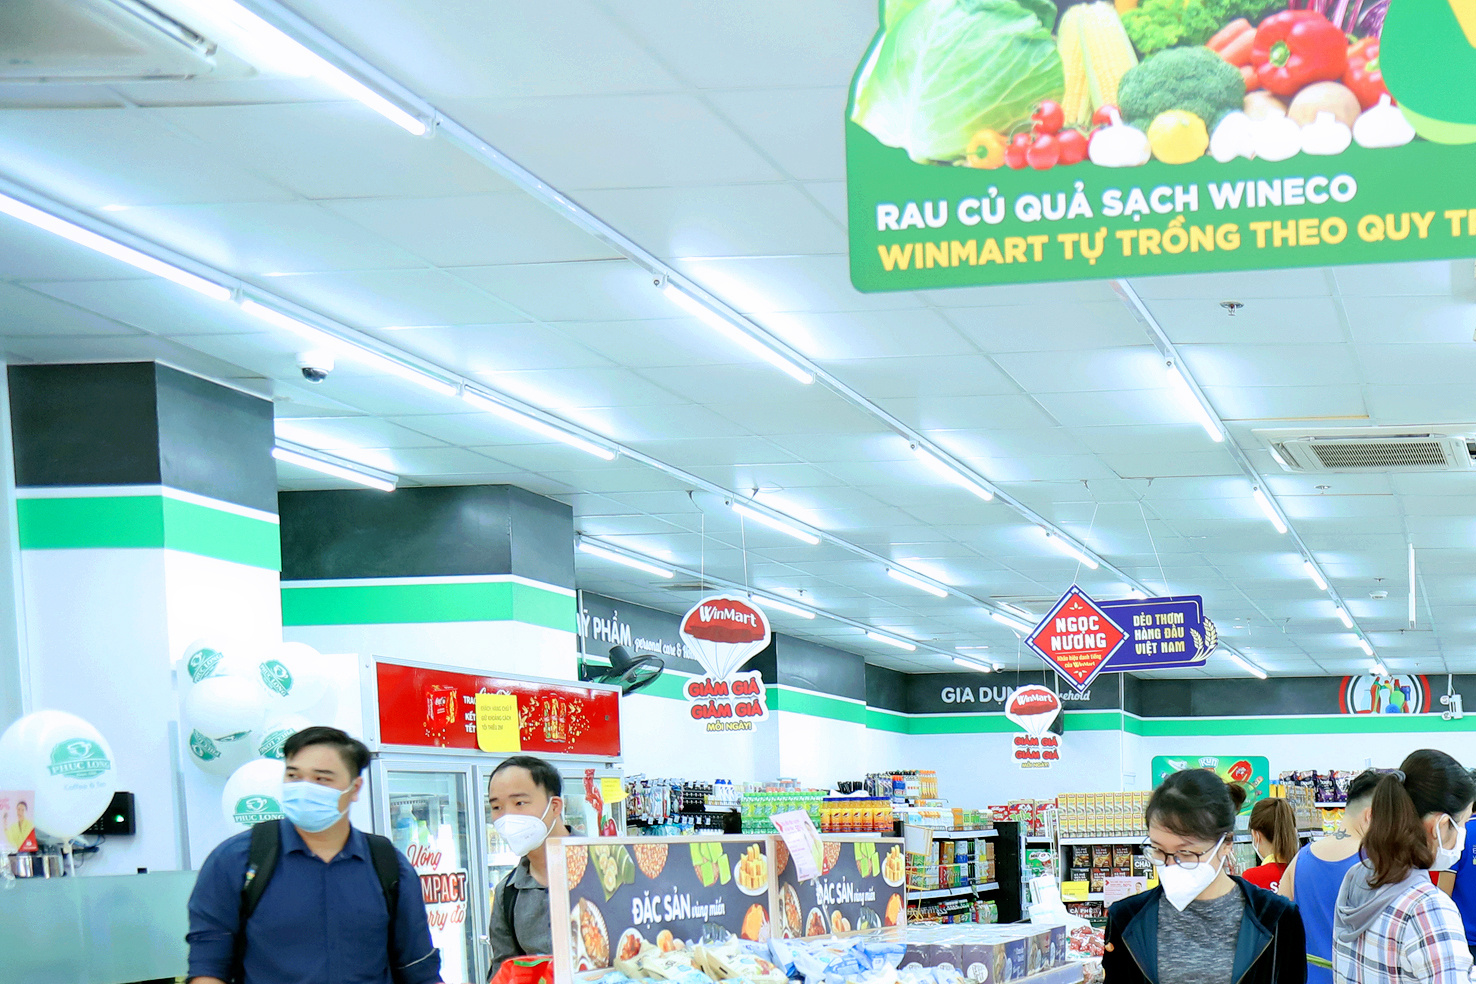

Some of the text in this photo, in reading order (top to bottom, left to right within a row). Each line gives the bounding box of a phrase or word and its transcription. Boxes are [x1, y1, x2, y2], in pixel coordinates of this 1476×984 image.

[877, 173, 1358, 231] RAU CỦ QUẢ SẠCH WINECO
[877, 235, 1048, 272] WINMART
[1057, 227, 1108, 266] TỰ
[1115, 215, 1241, 256] TRỒNG
[1250, 216, 1348, 248] THEO
[1357, 211, 1436, 242] QUY
[699, 605, 758, 628] WinMart
[1055, 615, 1100, 634] NGỌC
[1133, 612, 1185, 627] DẺO THƠM
[593, 610, 632, 647] PHẨM
[1134, 624, 1185, 641] HÀNG ĐẦU
[1050, 633, 1107, 651] NƯƠNG
[1135, 641, 1186, 656] VIỆT NAM
[688, 677, 760, 697] GIẢM GIÁ
[941, 686, 975, 703] GIA
[691, 699, 763, 719] GIẢM GIÁ
[1016, 695, 1053, 706] WinMart
[1041, 736, 1058, 747] GIÁ
[1042, 750, 1059, 760] GIÁ
[407, 844, 442, 871] Uống
[836, 876, 854, 904] SẢN
[632, 890, 661, 929] ĐẶC
[664, 886, 691, 922] SẢN
